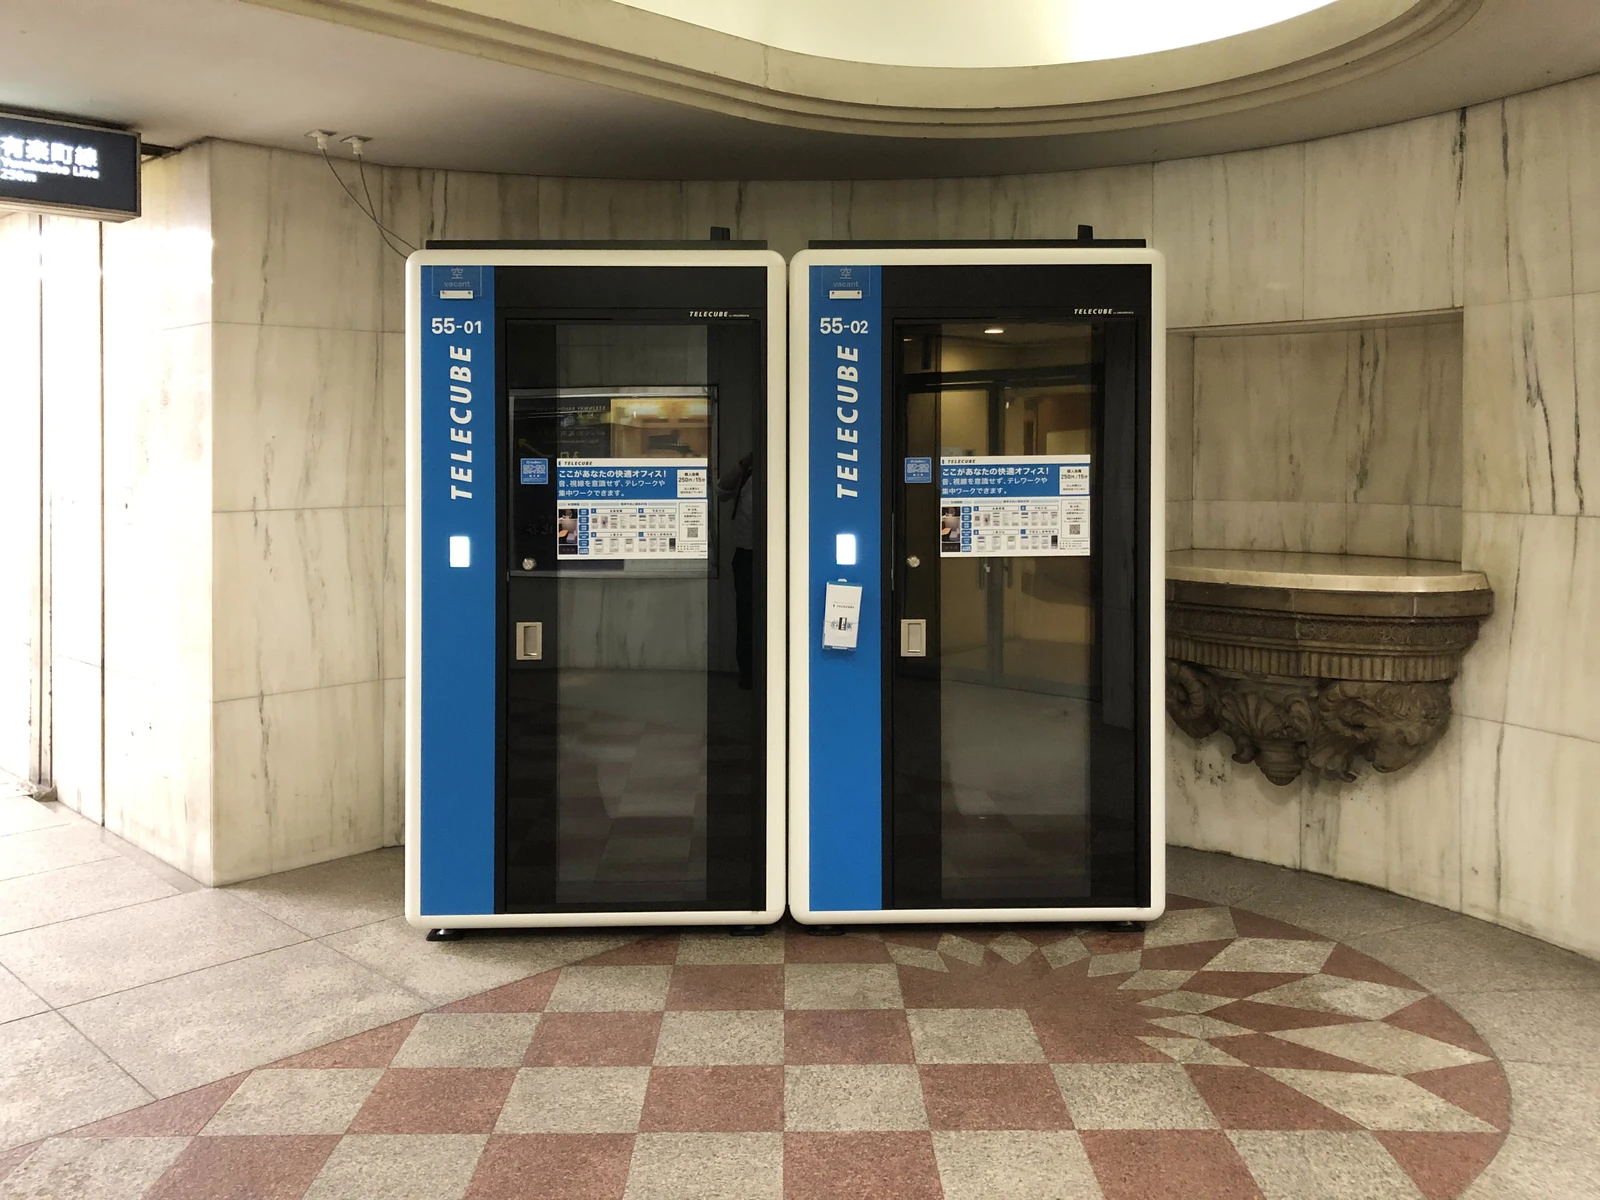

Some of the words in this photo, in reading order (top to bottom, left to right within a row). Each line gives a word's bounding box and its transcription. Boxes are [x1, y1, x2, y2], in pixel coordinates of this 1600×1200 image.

[73, 166, 100, 179] Line
[839, 267, 852, 280] 空
[431, 317, 482, 335] 55-01
[819, 317, 869, 335] 55-02
[450, 345, 473, 500] TELECUBE
[837, 345, 859, 499] TELECUBE
[558, 480, 666, 488] 音、視線を意識せず、テレワークや
[941, 477, 1048, 486] 音、視線を意識せず、テレワークや
[558, 489, 625, 497] 集中ワークできます。
[941, 487, 1007, 495] 集中ワークできます。
